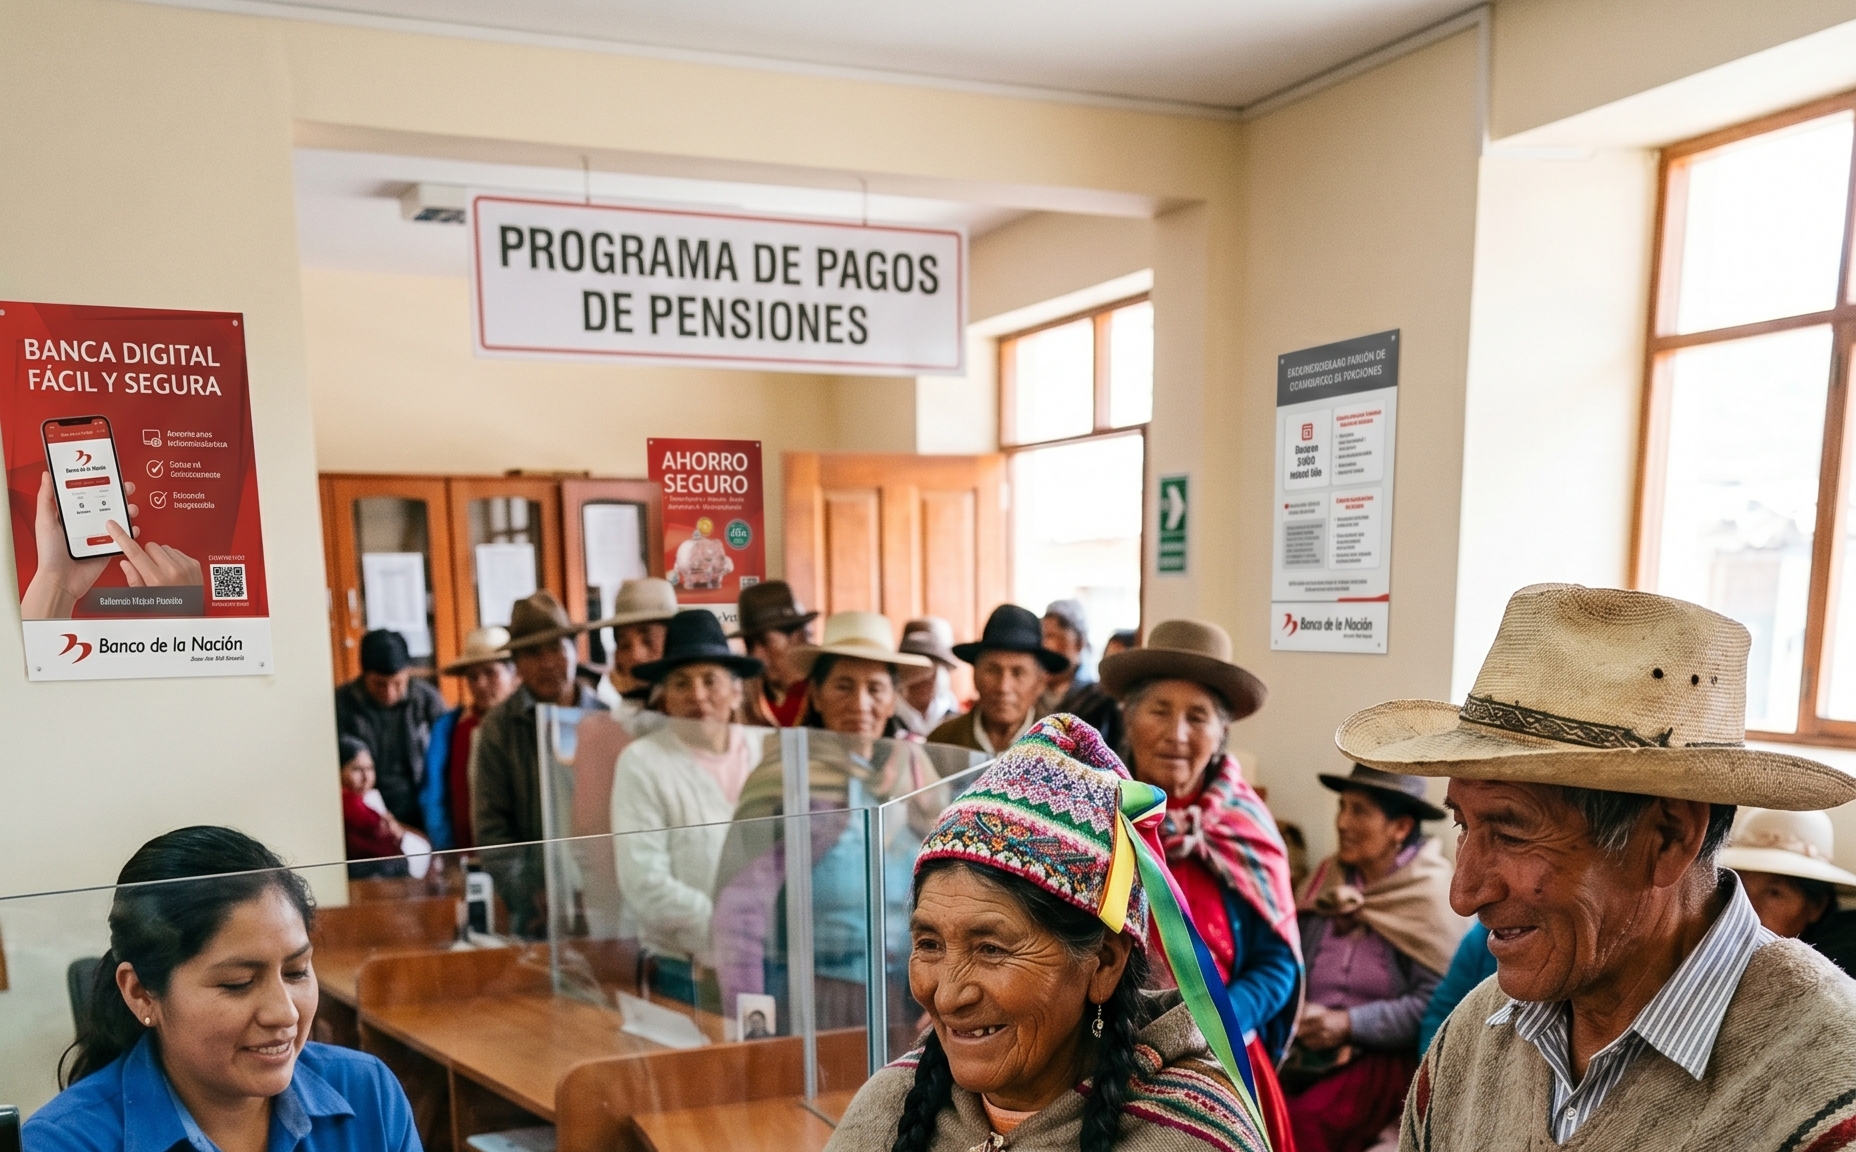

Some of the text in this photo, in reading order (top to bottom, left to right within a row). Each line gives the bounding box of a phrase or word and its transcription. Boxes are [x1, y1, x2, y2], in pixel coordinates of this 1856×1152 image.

[499, 225, 939, 295] PROGRAMA DE PAGOS
[582, 290, 868, 345] DE PENSIONES
[24, 338, 220, 368] BANCA DIGITAL
[28, 365, 222, 397] FÁCIL Y SEGURA
[662, 451, 748, 471] AHORRO
[664, 474, 748, 494] SEGURO
[100, 636, 242, 654] Banco de la Nación
